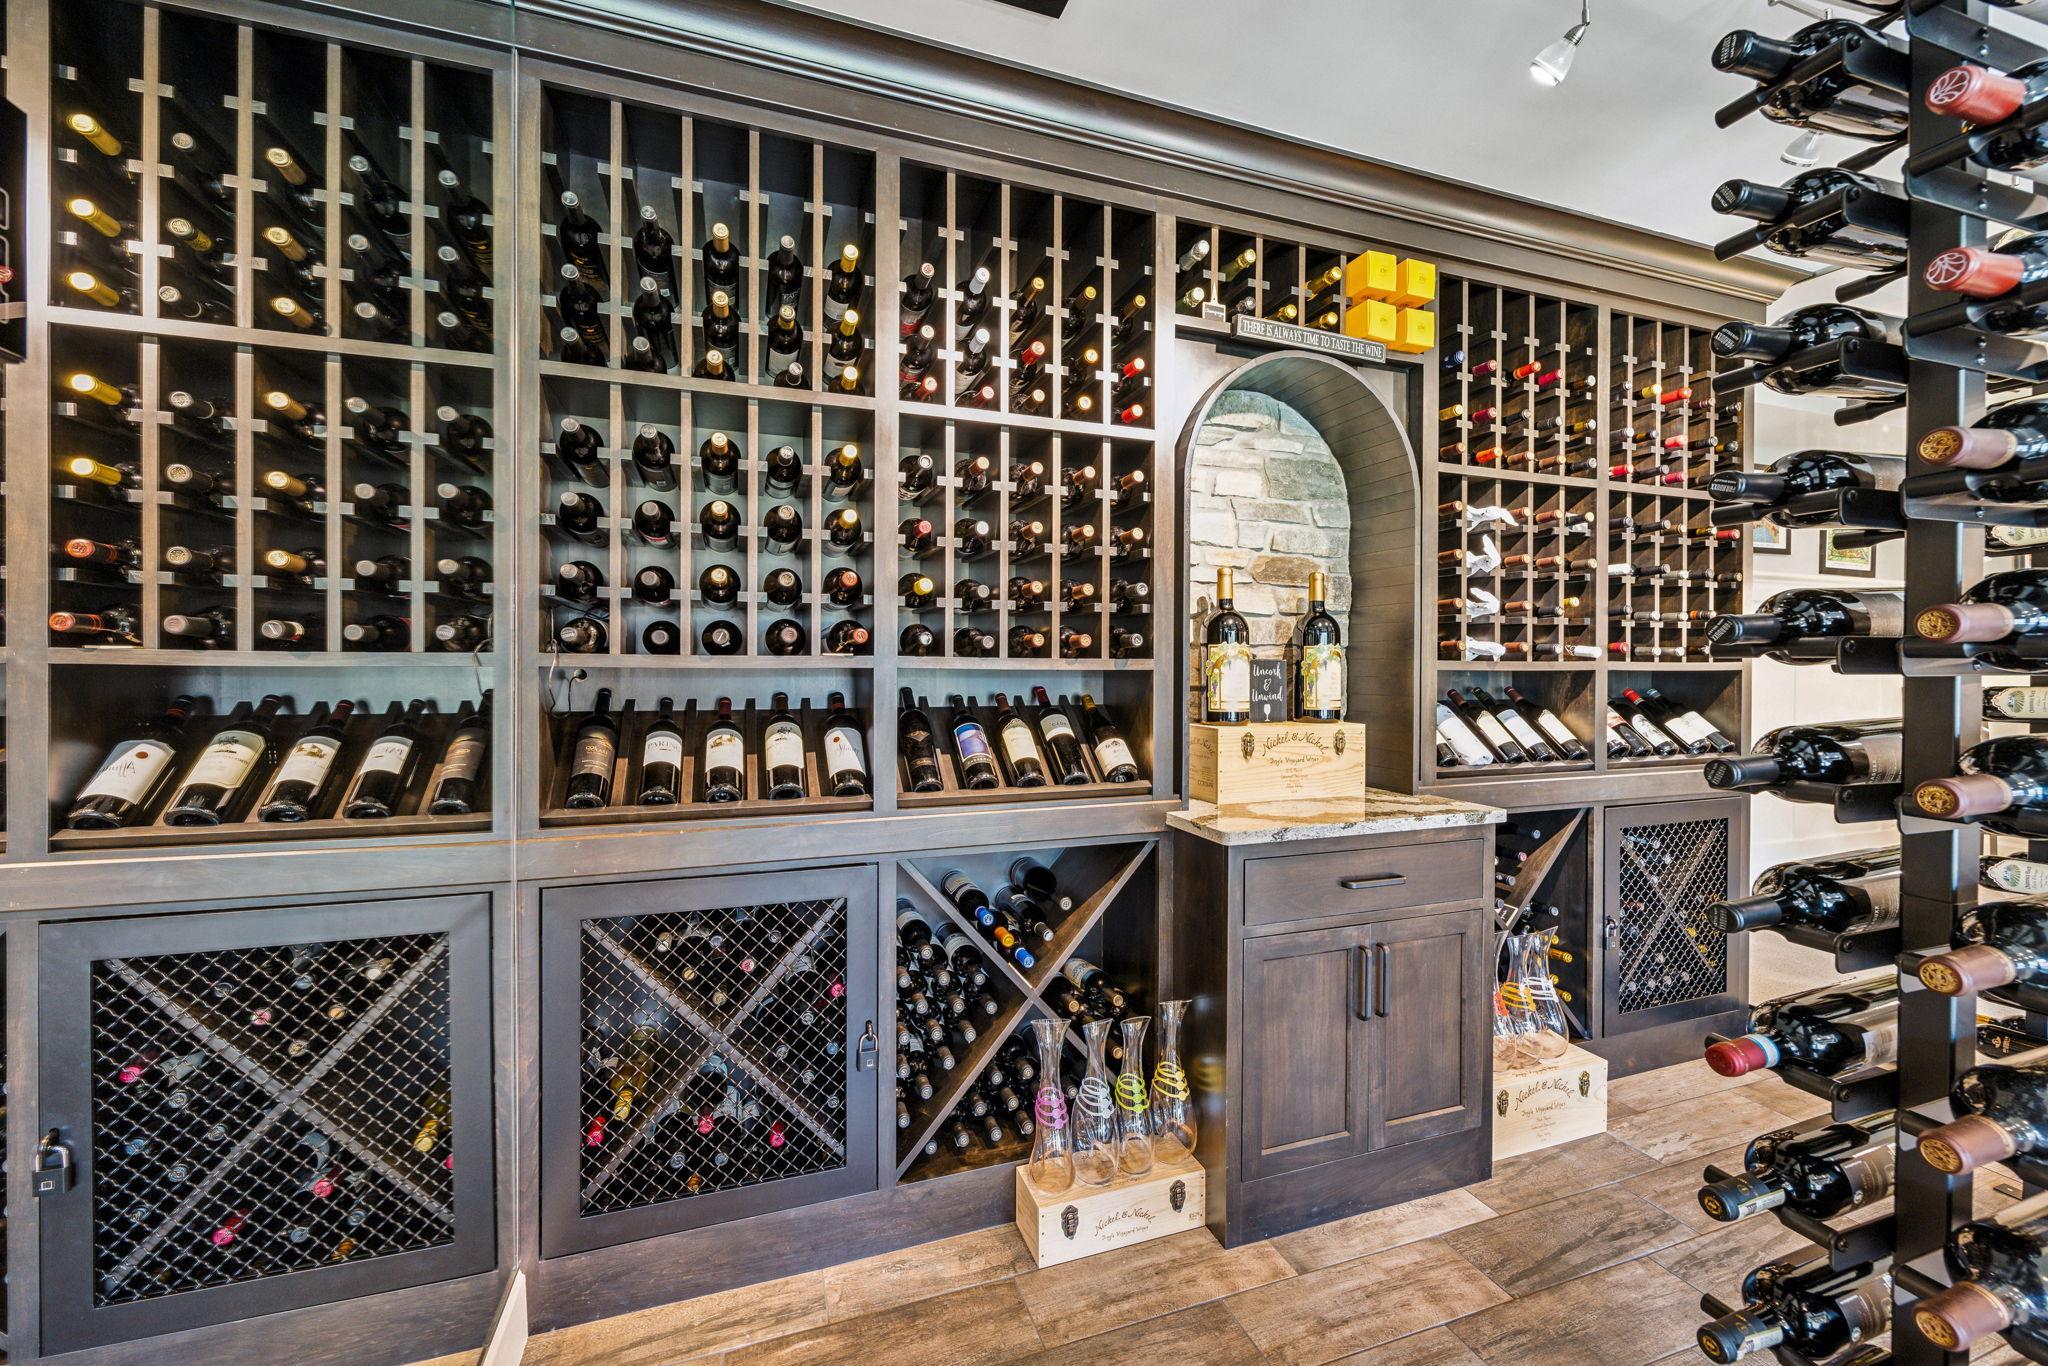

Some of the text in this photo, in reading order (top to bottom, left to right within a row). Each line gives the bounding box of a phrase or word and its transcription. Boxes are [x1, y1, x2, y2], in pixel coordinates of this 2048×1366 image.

[1243, 320, 1382, 358] THERE IS ALWAYS TIME TO TASTE THE WINE
[1253, 662, 1282, 679] Uncork
[1264, 678, 1271, 691] &
[1252, 686, 1283, 702] Unwind
[1292, 733, 1298, 741] &
[1542, 1081, 1548, 1089] &
